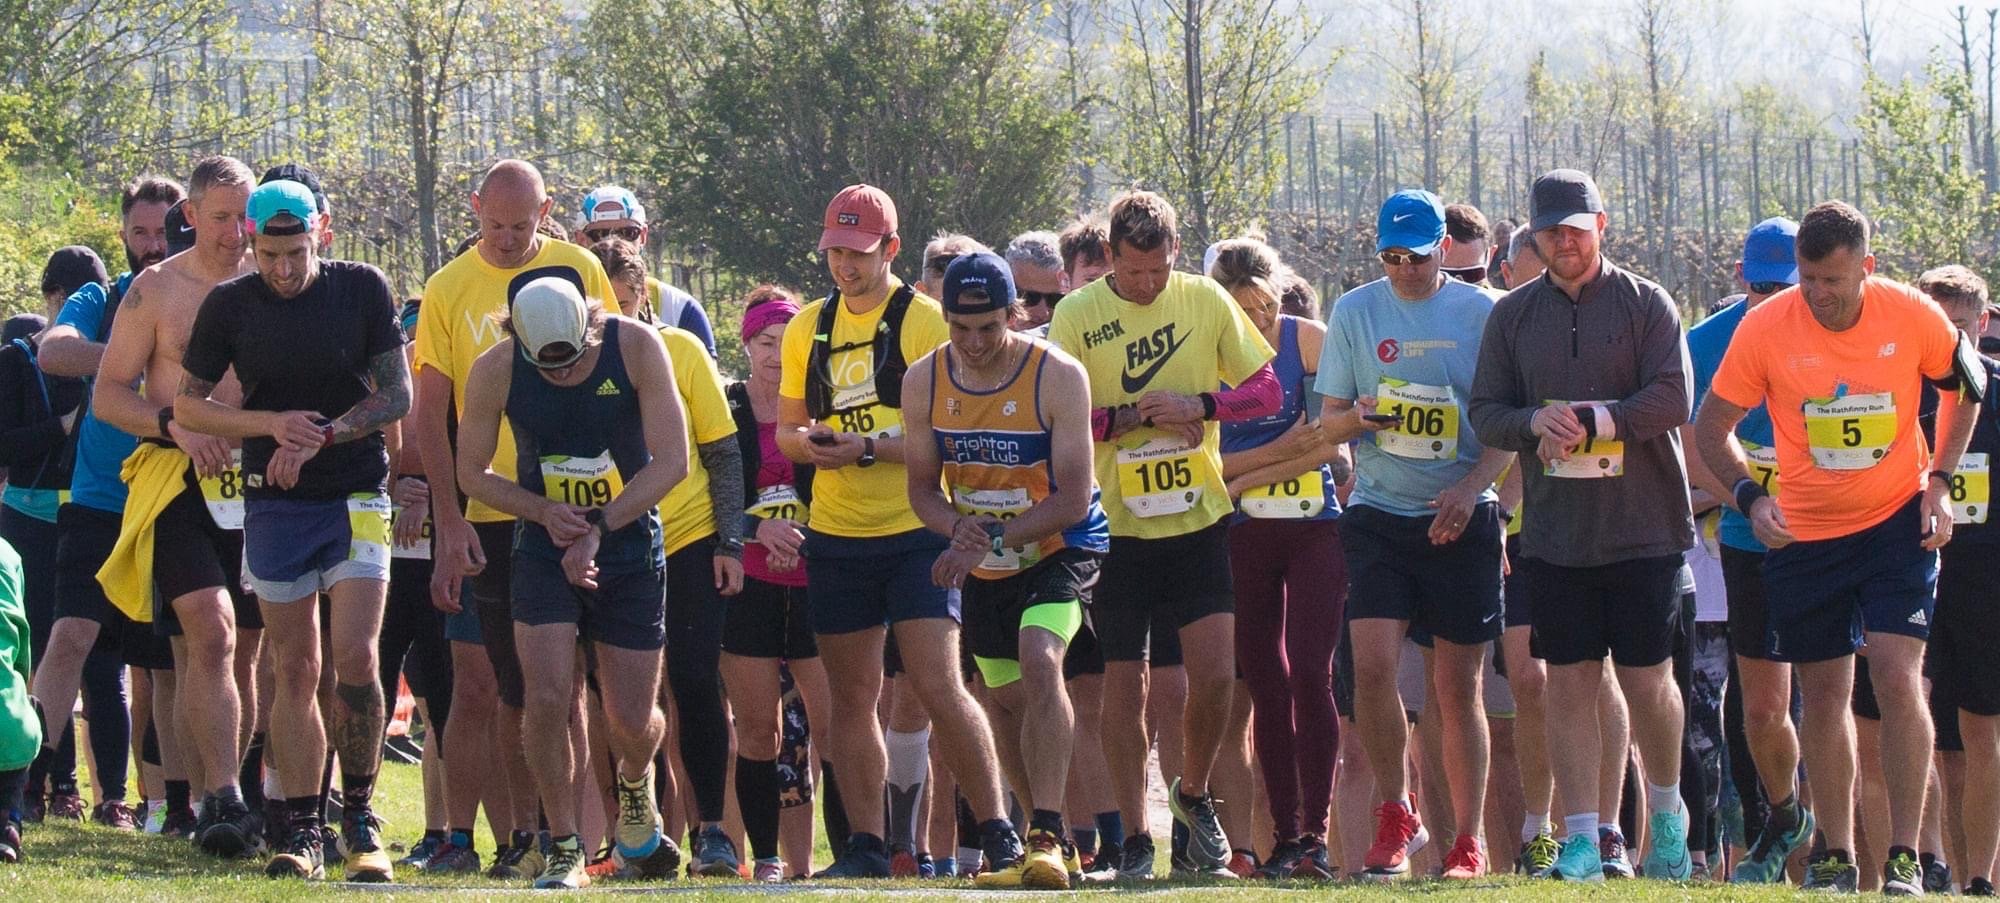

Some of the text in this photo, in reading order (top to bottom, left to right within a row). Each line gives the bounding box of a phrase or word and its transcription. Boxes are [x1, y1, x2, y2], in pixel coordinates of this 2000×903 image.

[1083, 319, 1125, 350] F#CK
[1126, 322, 1175, 371] FAST
[1389, 388, 1402, 396] The
[1402, 390, 1435, 403] Rathfinny
[1831, 405, 1867, 414] Rathfinny
[1392, 403, 1444, 436] 106
[1842, 418, 1862, 447] 5
[945, 436, 1018, 450] Brighton
[981, 449, 1019, 463] Club
[1143, 447, 1177, 458] Rathfinny
[1135, 457, 1191, 493] 105
[560, 478, 612, 507] 109
